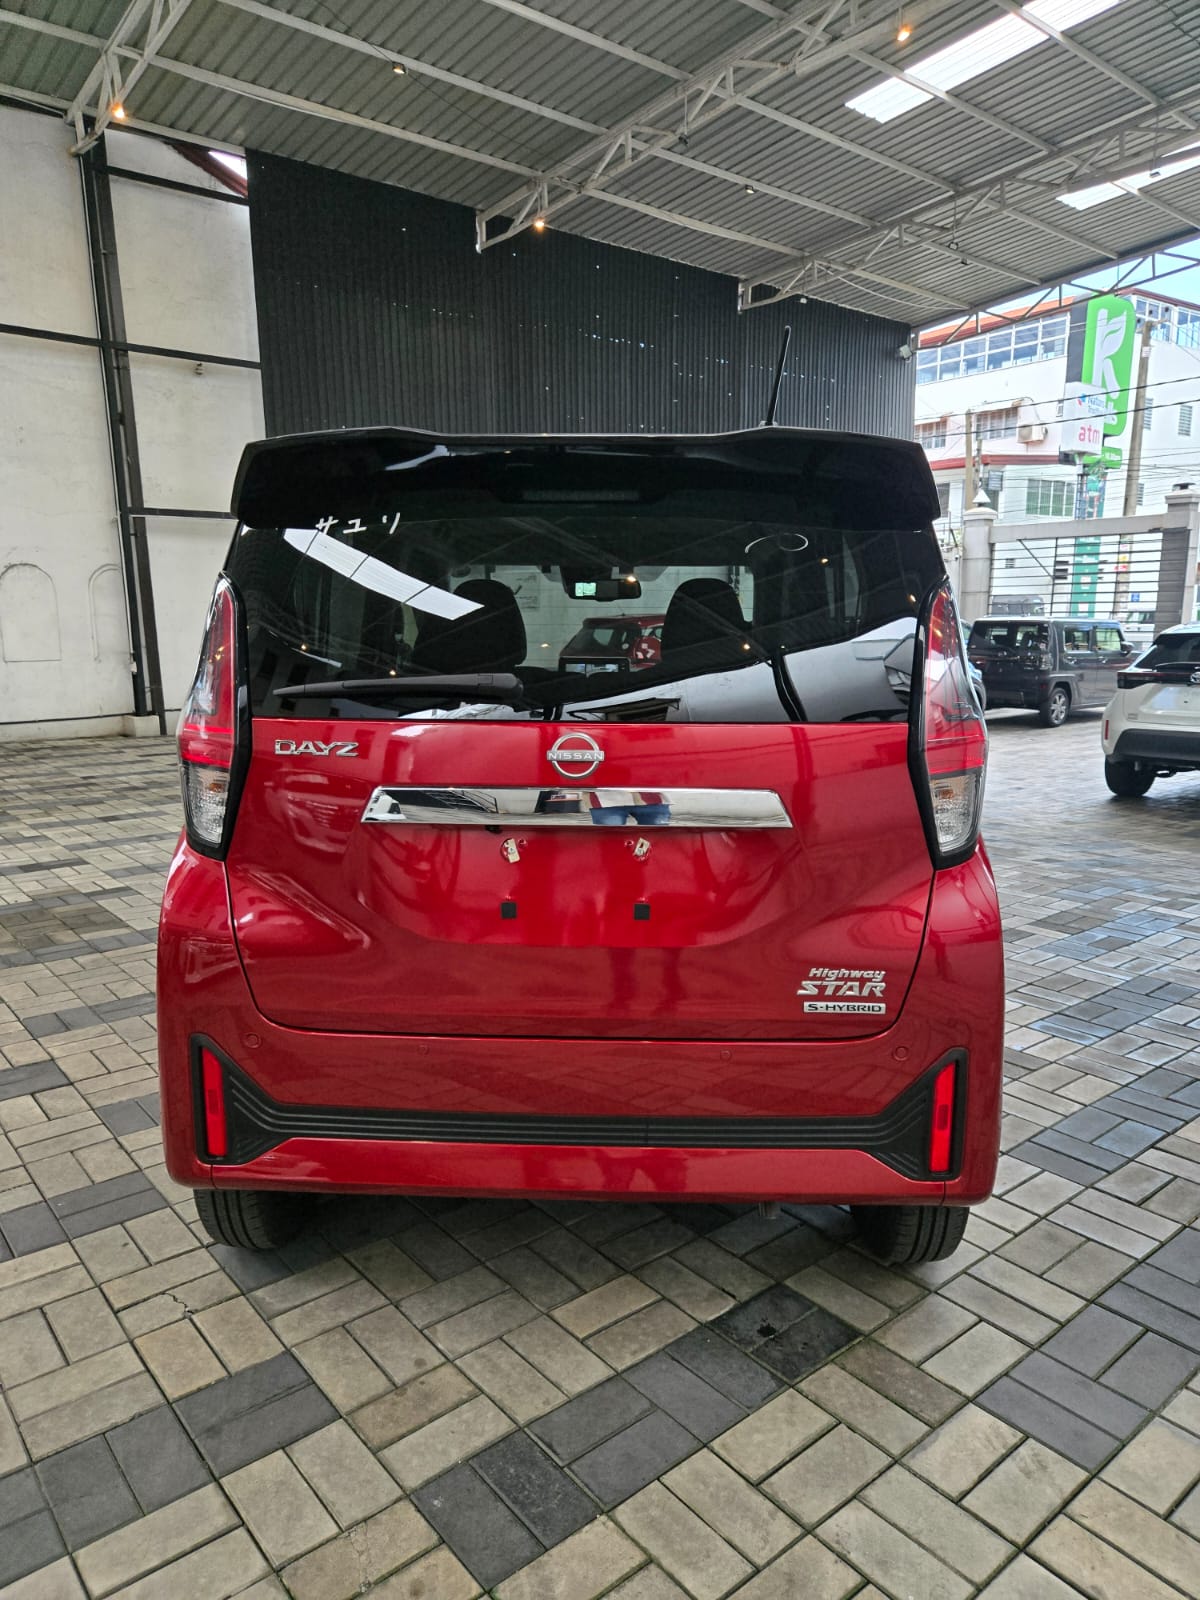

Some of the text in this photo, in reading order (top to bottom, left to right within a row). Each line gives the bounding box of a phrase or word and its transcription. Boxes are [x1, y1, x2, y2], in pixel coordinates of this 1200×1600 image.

[1078, 425, 1100, 443] atm
[274, 739, 359, 756] DAYZ
[548, 752, 603, 760] NISSAN
[808, 967, 886, 982] Highway
[796, 980, 886, 997] STAR
[807, 1003, 882, 1012] S-HYBRID
